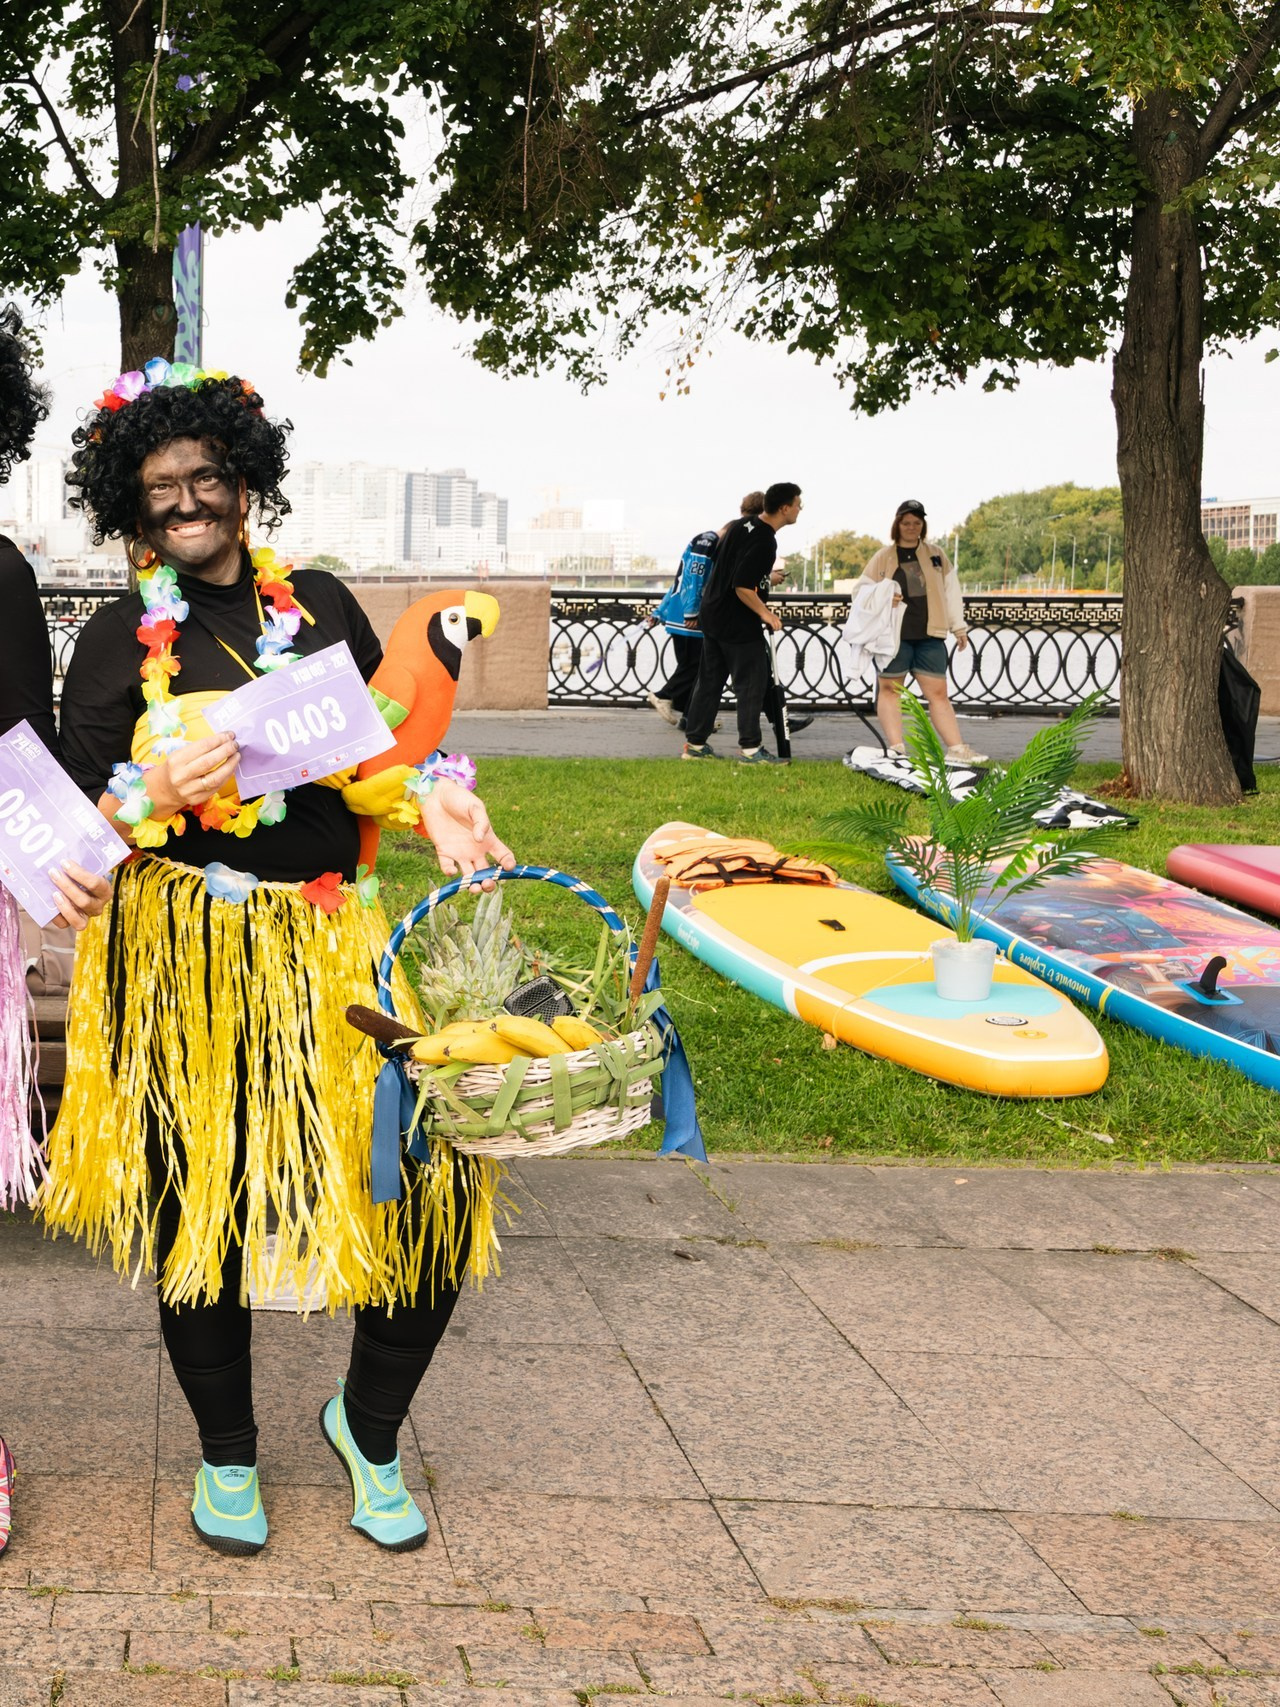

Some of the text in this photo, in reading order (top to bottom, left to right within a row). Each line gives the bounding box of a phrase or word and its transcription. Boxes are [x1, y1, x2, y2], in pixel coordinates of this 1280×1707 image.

[691, 561, 705, 577] 28
[264, 696, 347, 755] 0403
[1019, 952, 1047, 978] Explore
[1055, 972, 1091, 1001] Innovate
